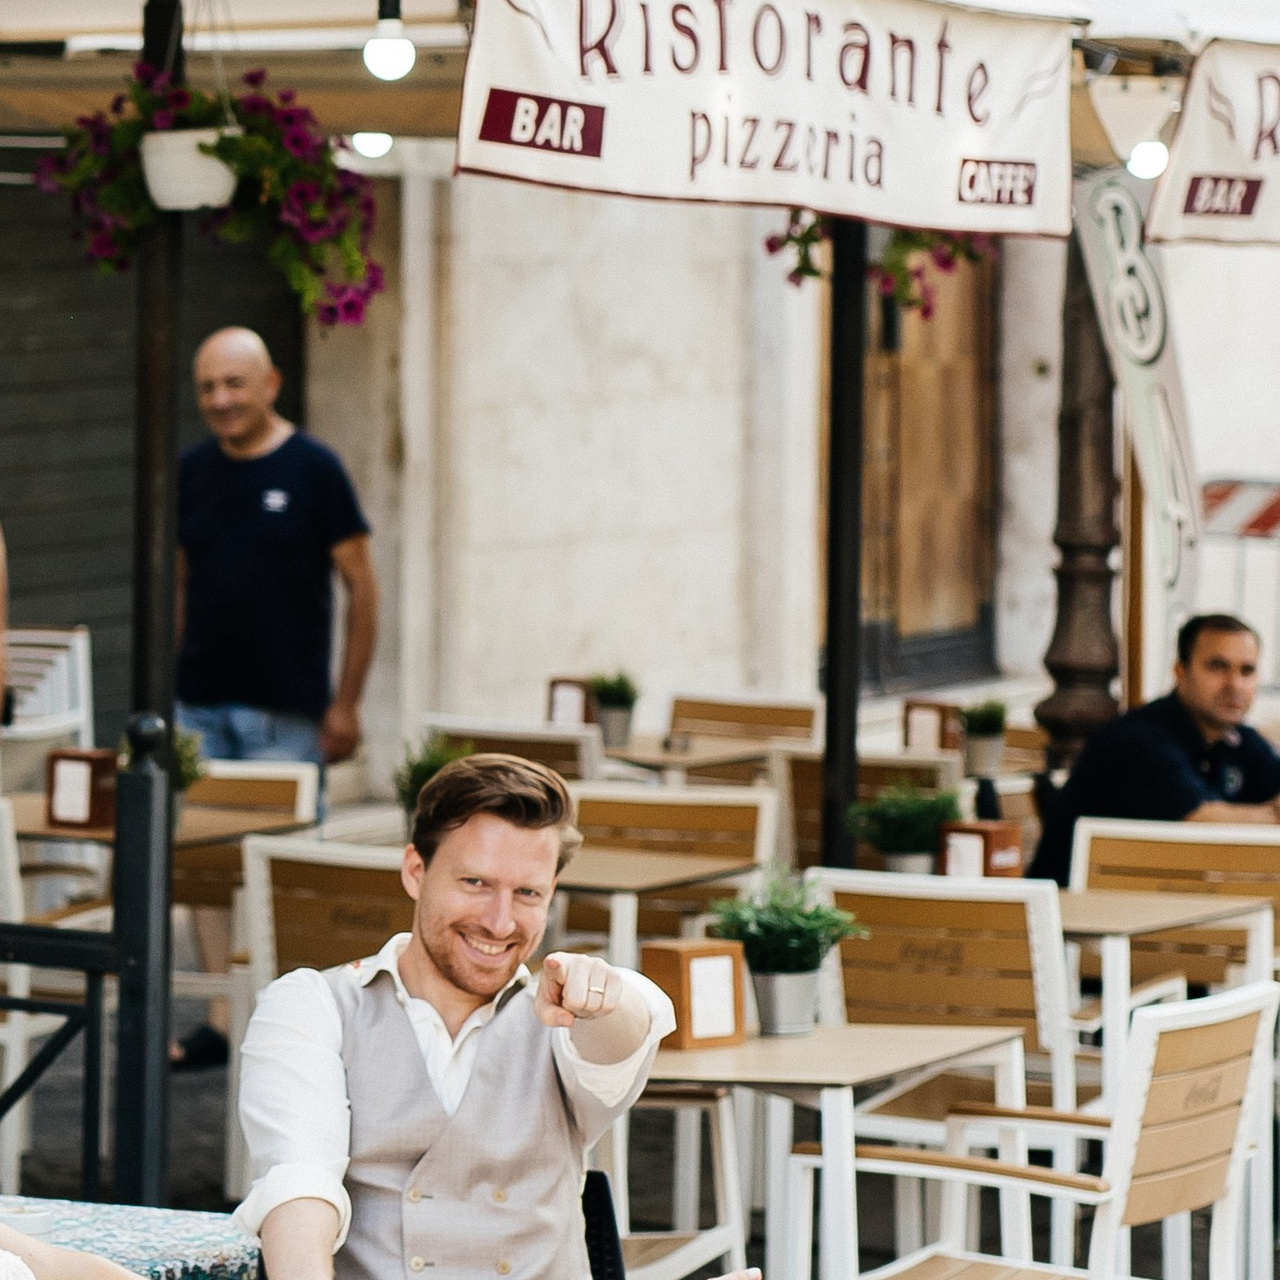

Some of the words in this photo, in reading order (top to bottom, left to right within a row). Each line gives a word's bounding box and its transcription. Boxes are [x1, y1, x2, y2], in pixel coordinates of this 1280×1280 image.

[510, 97, 585, 152] BAR
[690, 94, 884, 189] pizzeria
[1193, 179, 1247, 214] BAR
